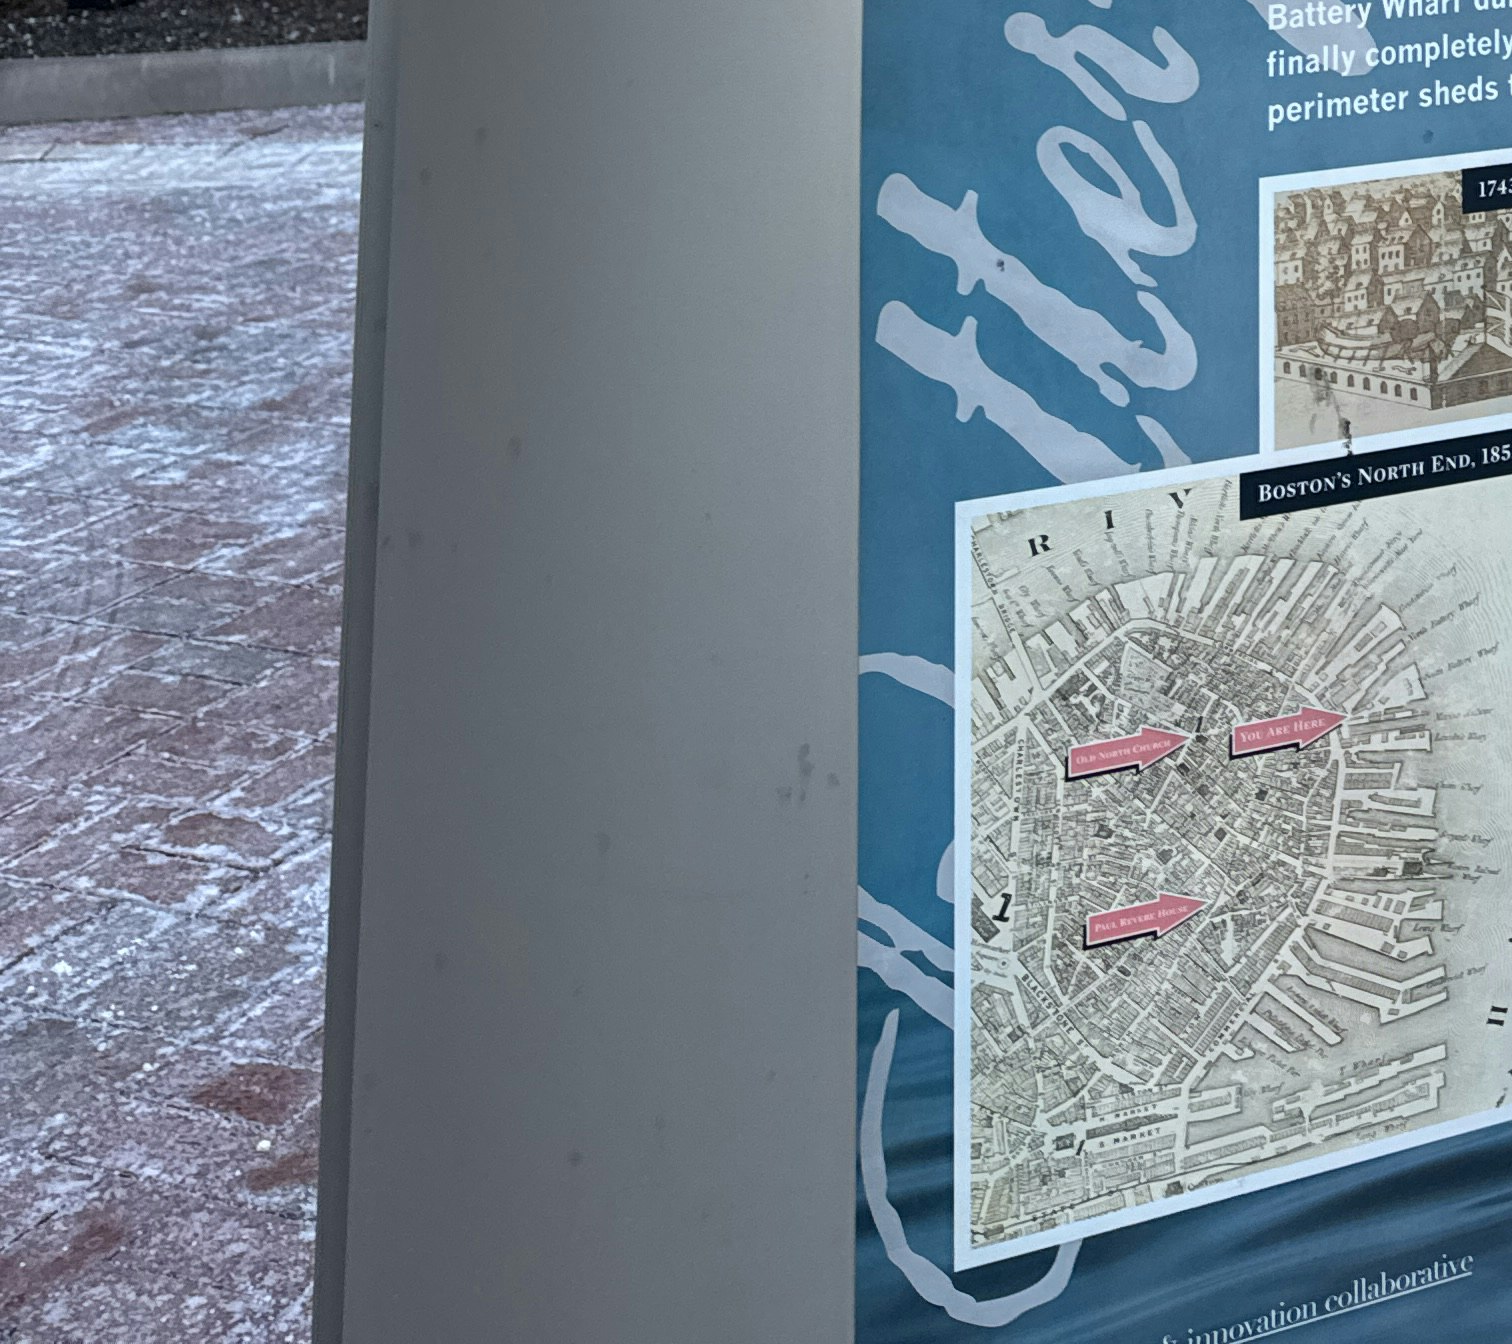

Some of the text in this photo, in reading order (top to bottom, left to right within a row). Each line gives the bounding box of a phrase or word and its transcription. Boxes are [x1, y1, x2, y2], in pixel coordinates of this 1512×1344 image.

[1265, 43, 1356, 78] finally
[1267, 87, 1410, 132] perimeter
[1418, 74, 1499, 108] sheds
[1357, 460, 1425, 486] NORTH
[1432, 453, 1476, 474] END,
[1240, 717, 1326, 743] YOU ARE HERE
[1186, 1252, 1475, 1344] innovation collaborative
